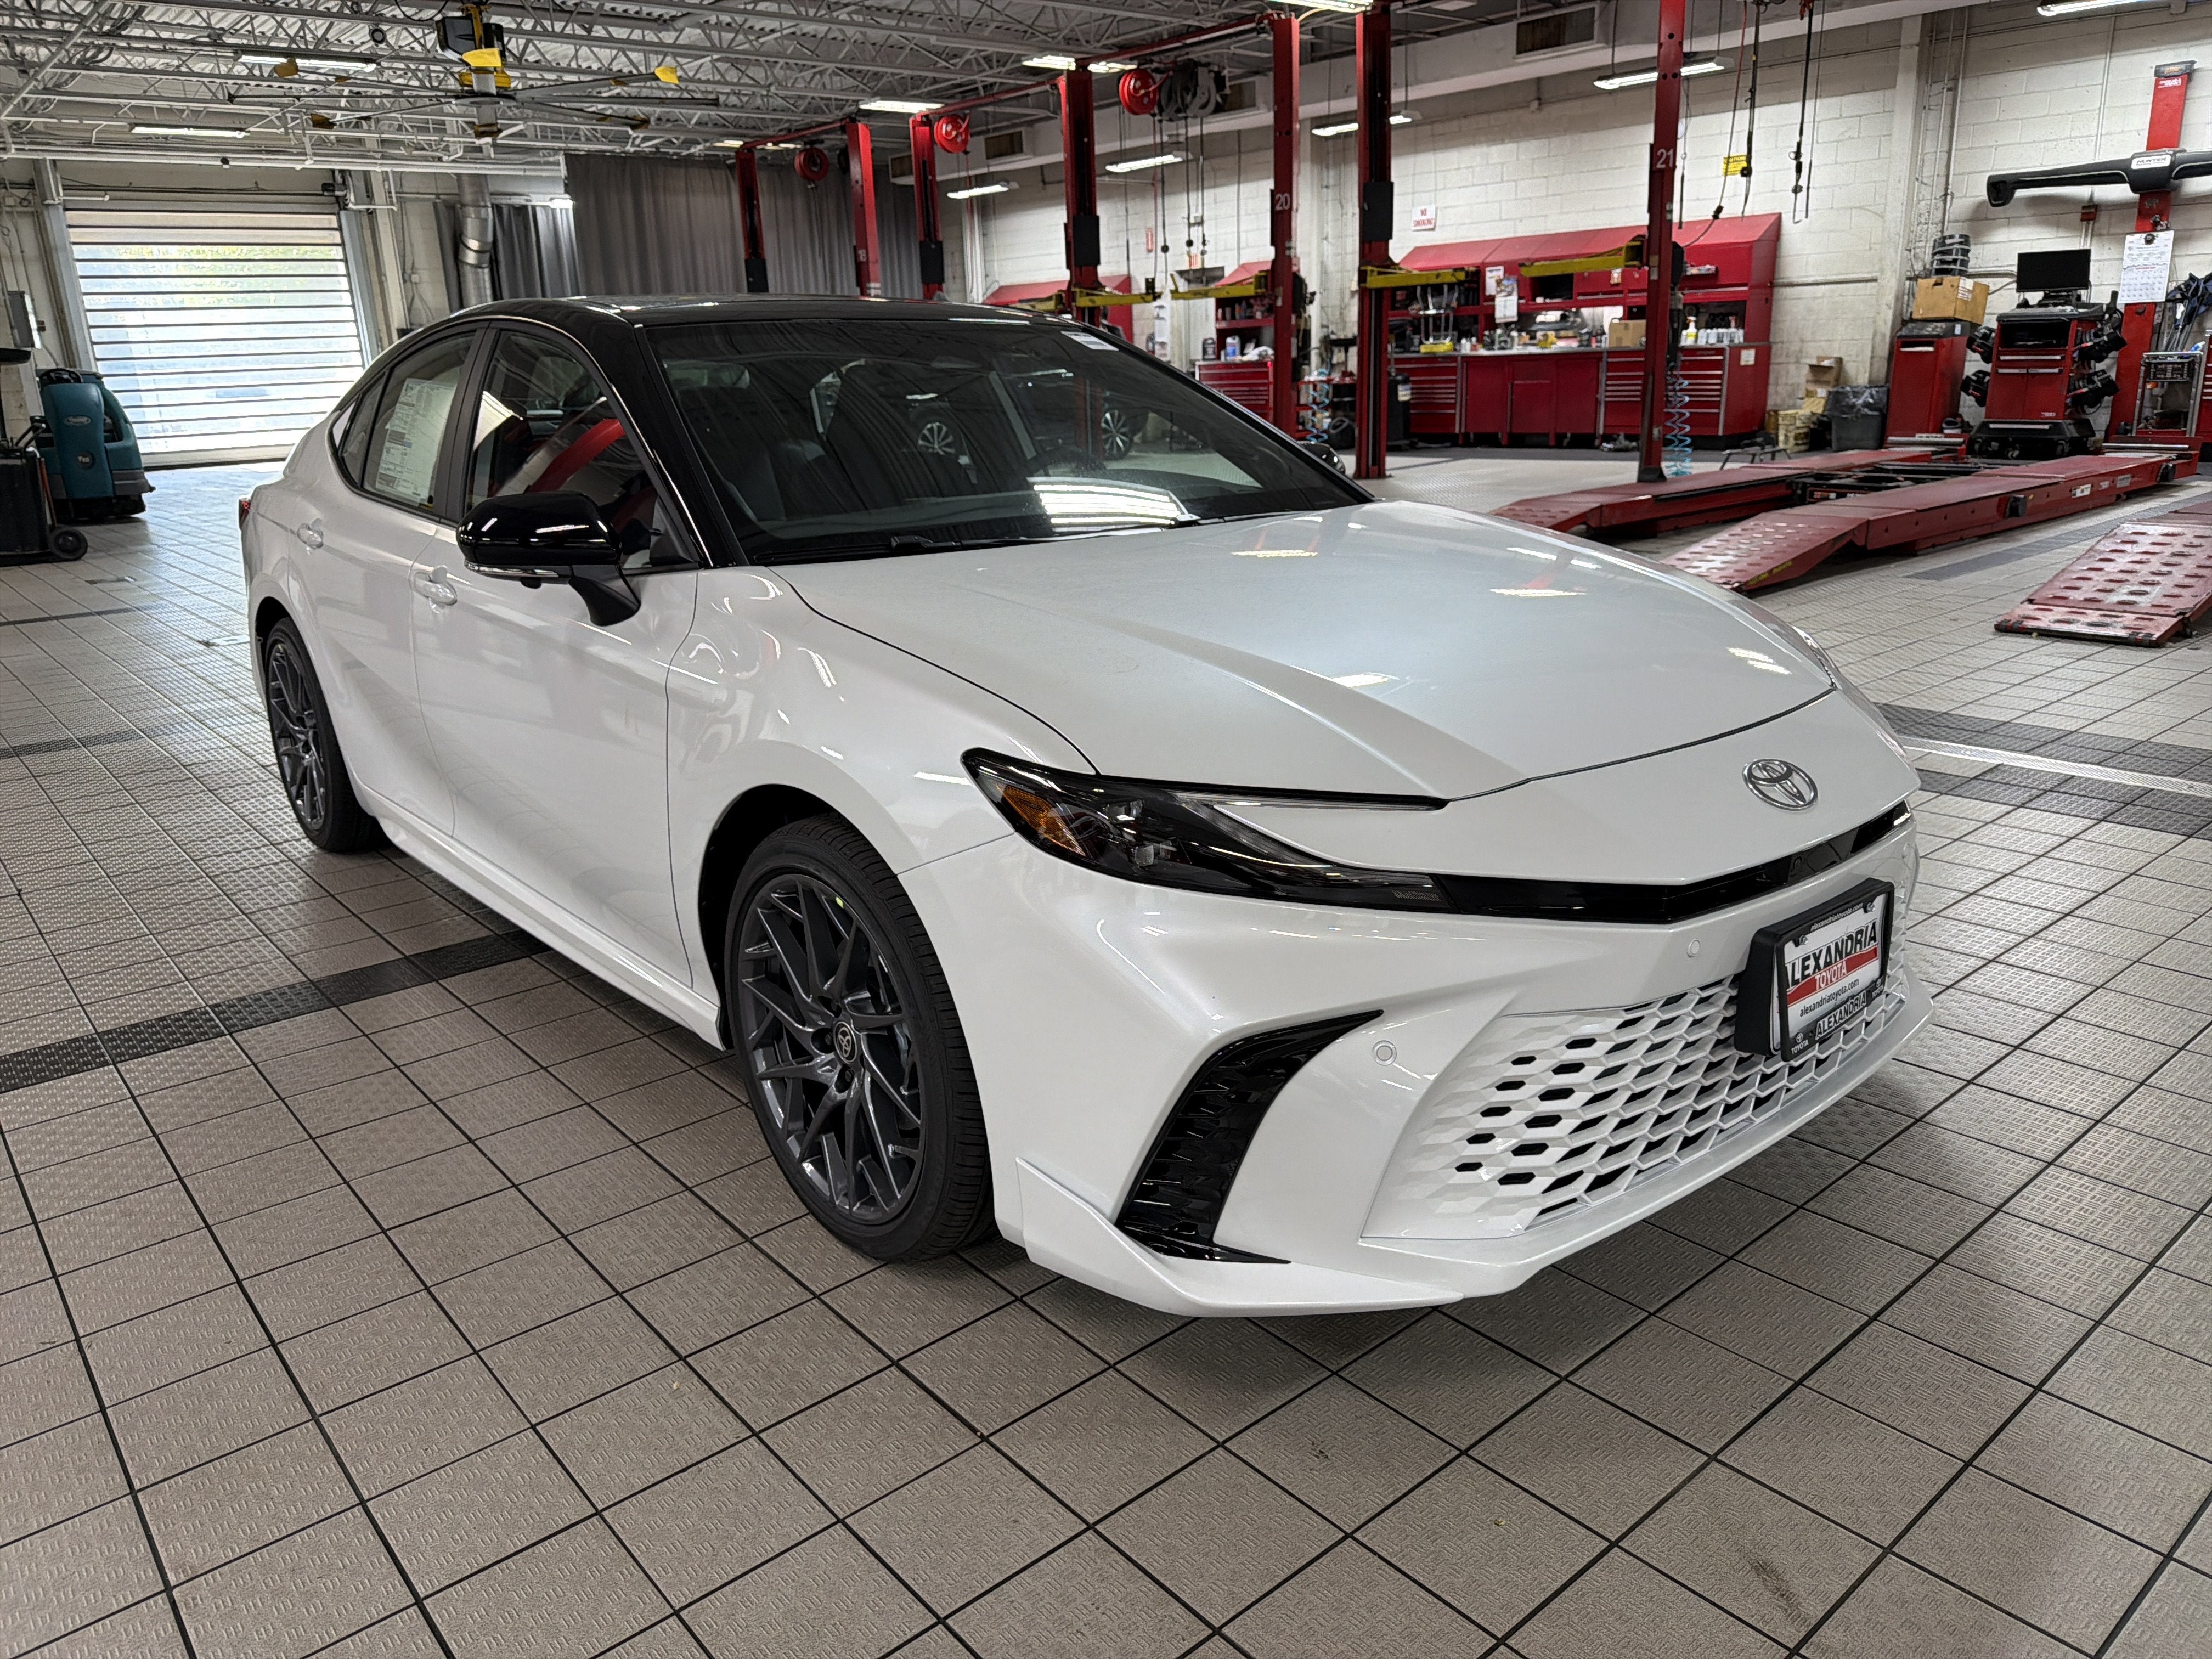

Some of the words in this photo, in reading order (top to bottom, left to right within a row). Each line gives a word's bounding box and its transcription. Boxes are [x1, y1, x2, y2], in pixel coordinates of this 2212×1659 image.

[1656, 148, 1673, 168] 21
[1275, 193, 1290, 210] 20
[1788, 919, 1878, 988] LEXANDRIA
[1815, 961, 1847, 990] TOYOTA
[1799, 979, 1859, 1017] alexandriatoyota.com
[1815, 991, 1866, 1040] ALEXANDRIA
[1791, 1039, 1809, 1054] TOYOTA
